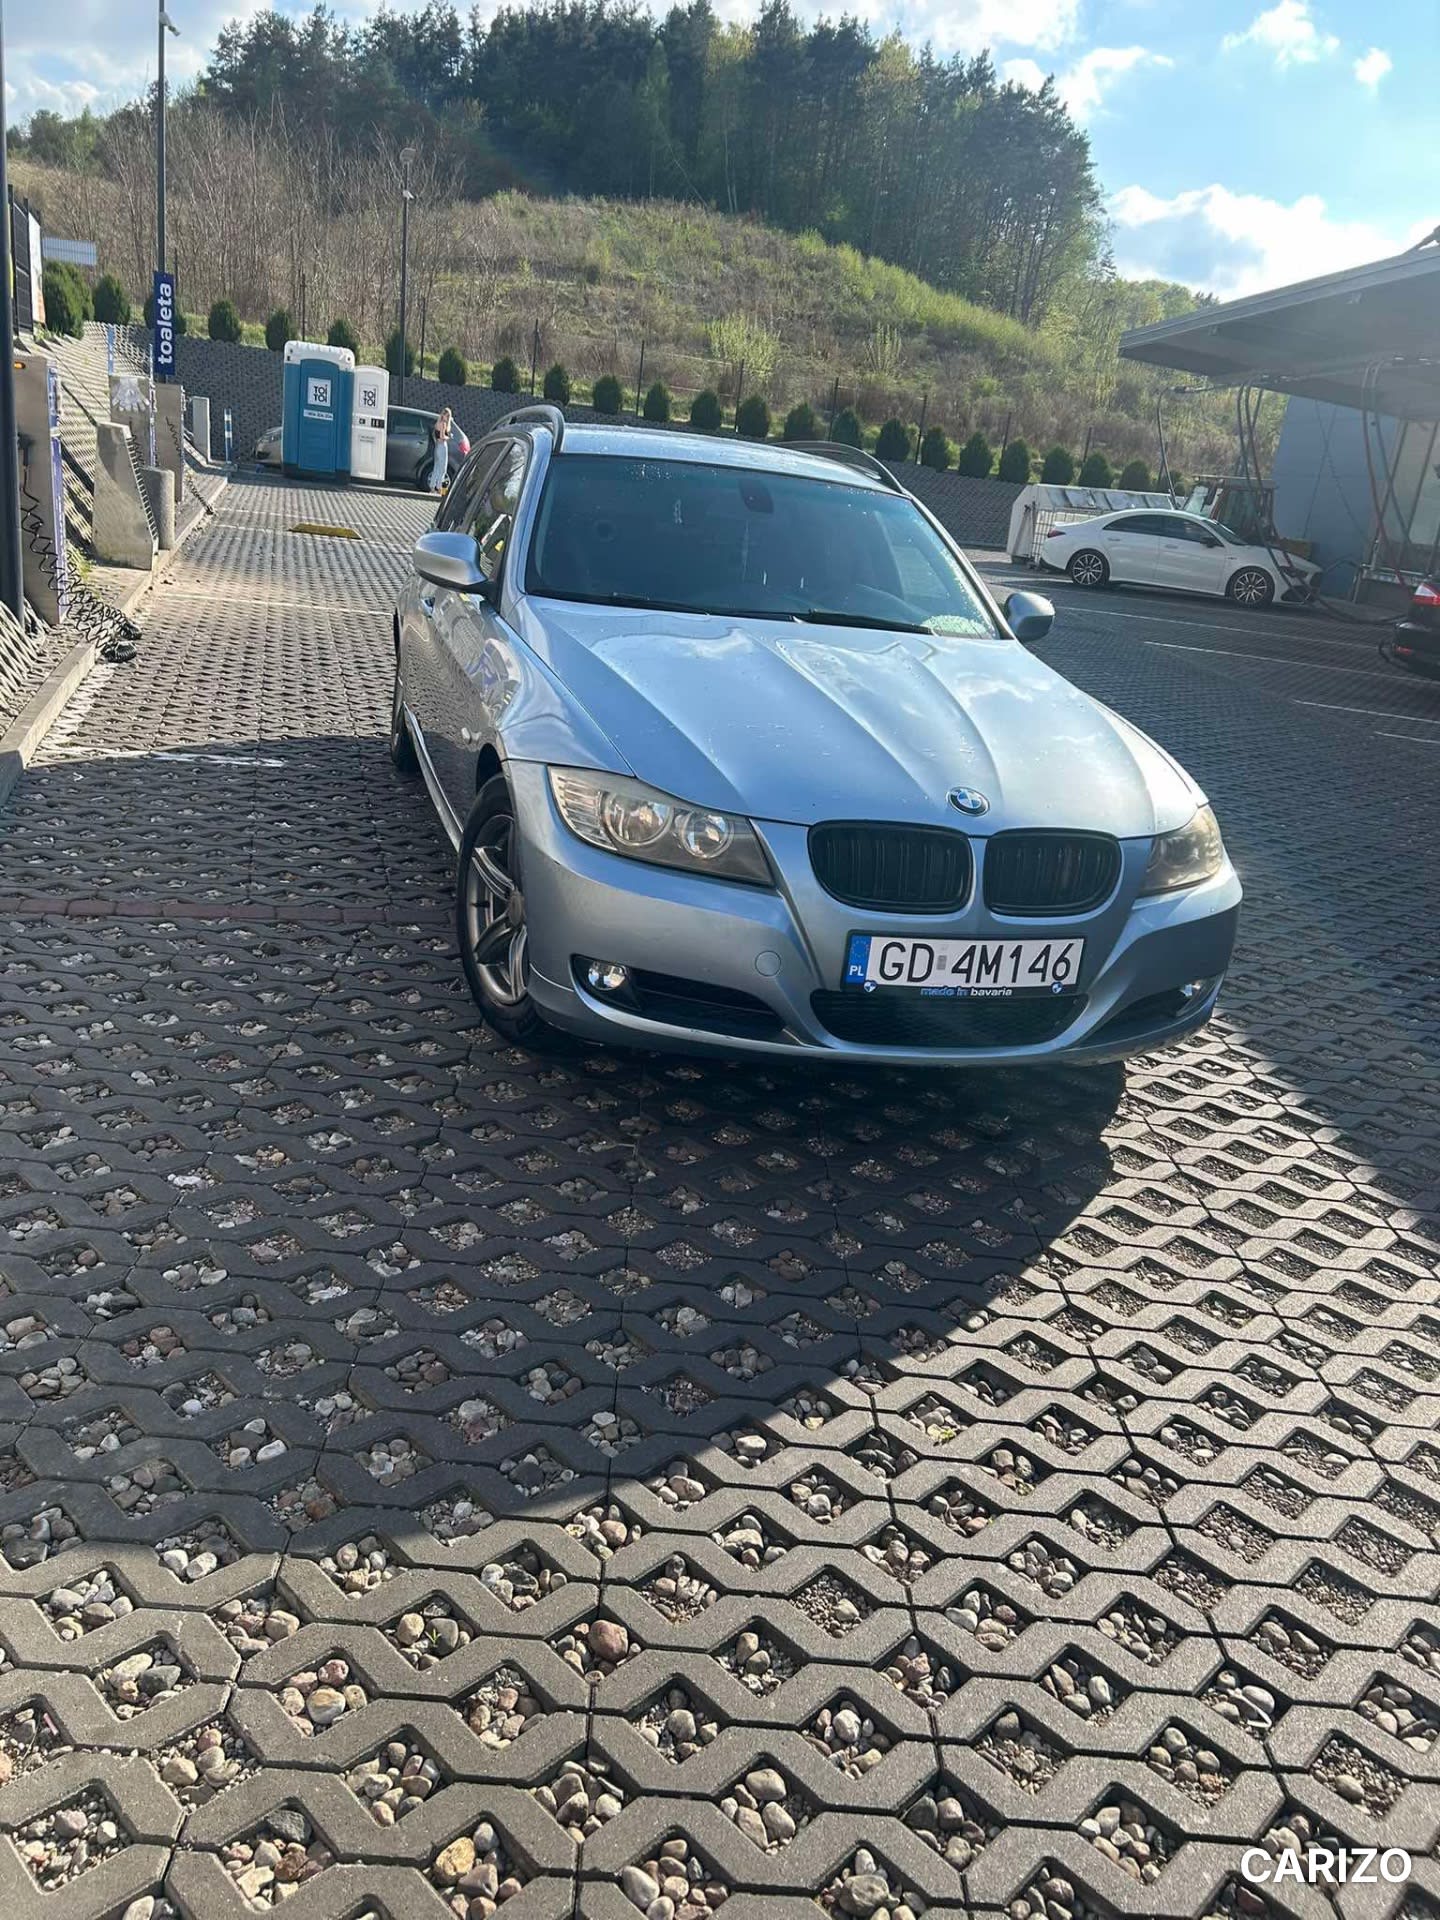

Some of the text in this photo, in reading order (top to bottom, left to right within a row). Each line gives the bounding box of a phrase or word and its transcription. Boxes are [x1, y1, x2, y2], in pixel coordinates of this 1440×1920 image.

[157, 283, 173, 365] toaleta
[849, 965, 864, 977] PL
[879, 941, 1074, 984] GD 4M146
[956, 987, 968, 996] in
[970, 987, 1013, 996] bavaria
